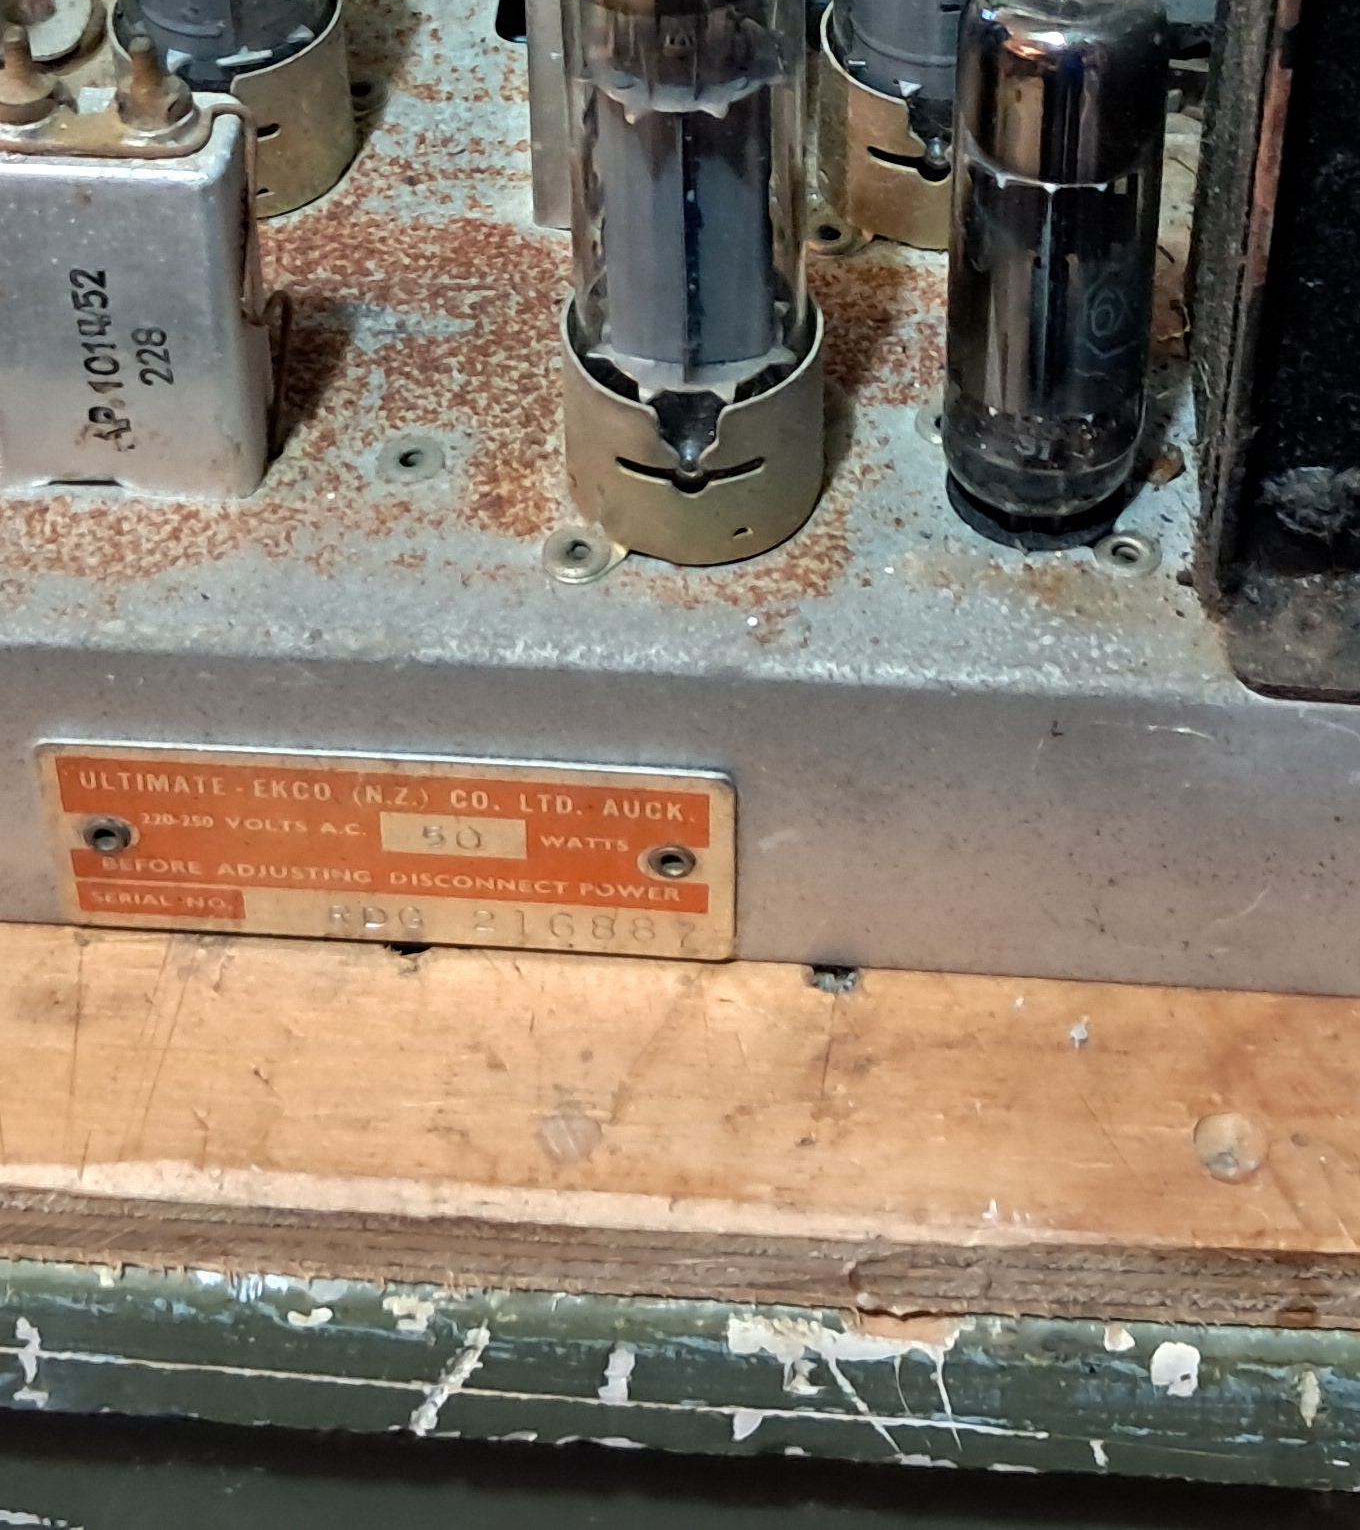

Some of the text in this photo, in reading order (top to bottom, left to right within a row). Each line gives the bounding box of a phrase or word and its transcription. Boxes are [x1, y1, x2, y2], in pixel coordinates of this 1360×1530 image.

[131, 326, 174, 386] 228
[252, 778, 333, 802] EKCO
[449, 789, 500, 812] CO.
[519, 792, 583, 816] LTD.
[602, 797, 695, 823] AUCK.
[225, 816, 308, 834] VOLTS
[320, 821, 367, 837] A.C.
[421, 825, 482, 851] 50
[539, 834, 630, 854] WATTS
[90, 890, 173, 908] SERIAL
[186, 894, 233, 912] NO.
[100, 855, 681, 903] BEFORE ADJUSTING DISCONNECT POWER
